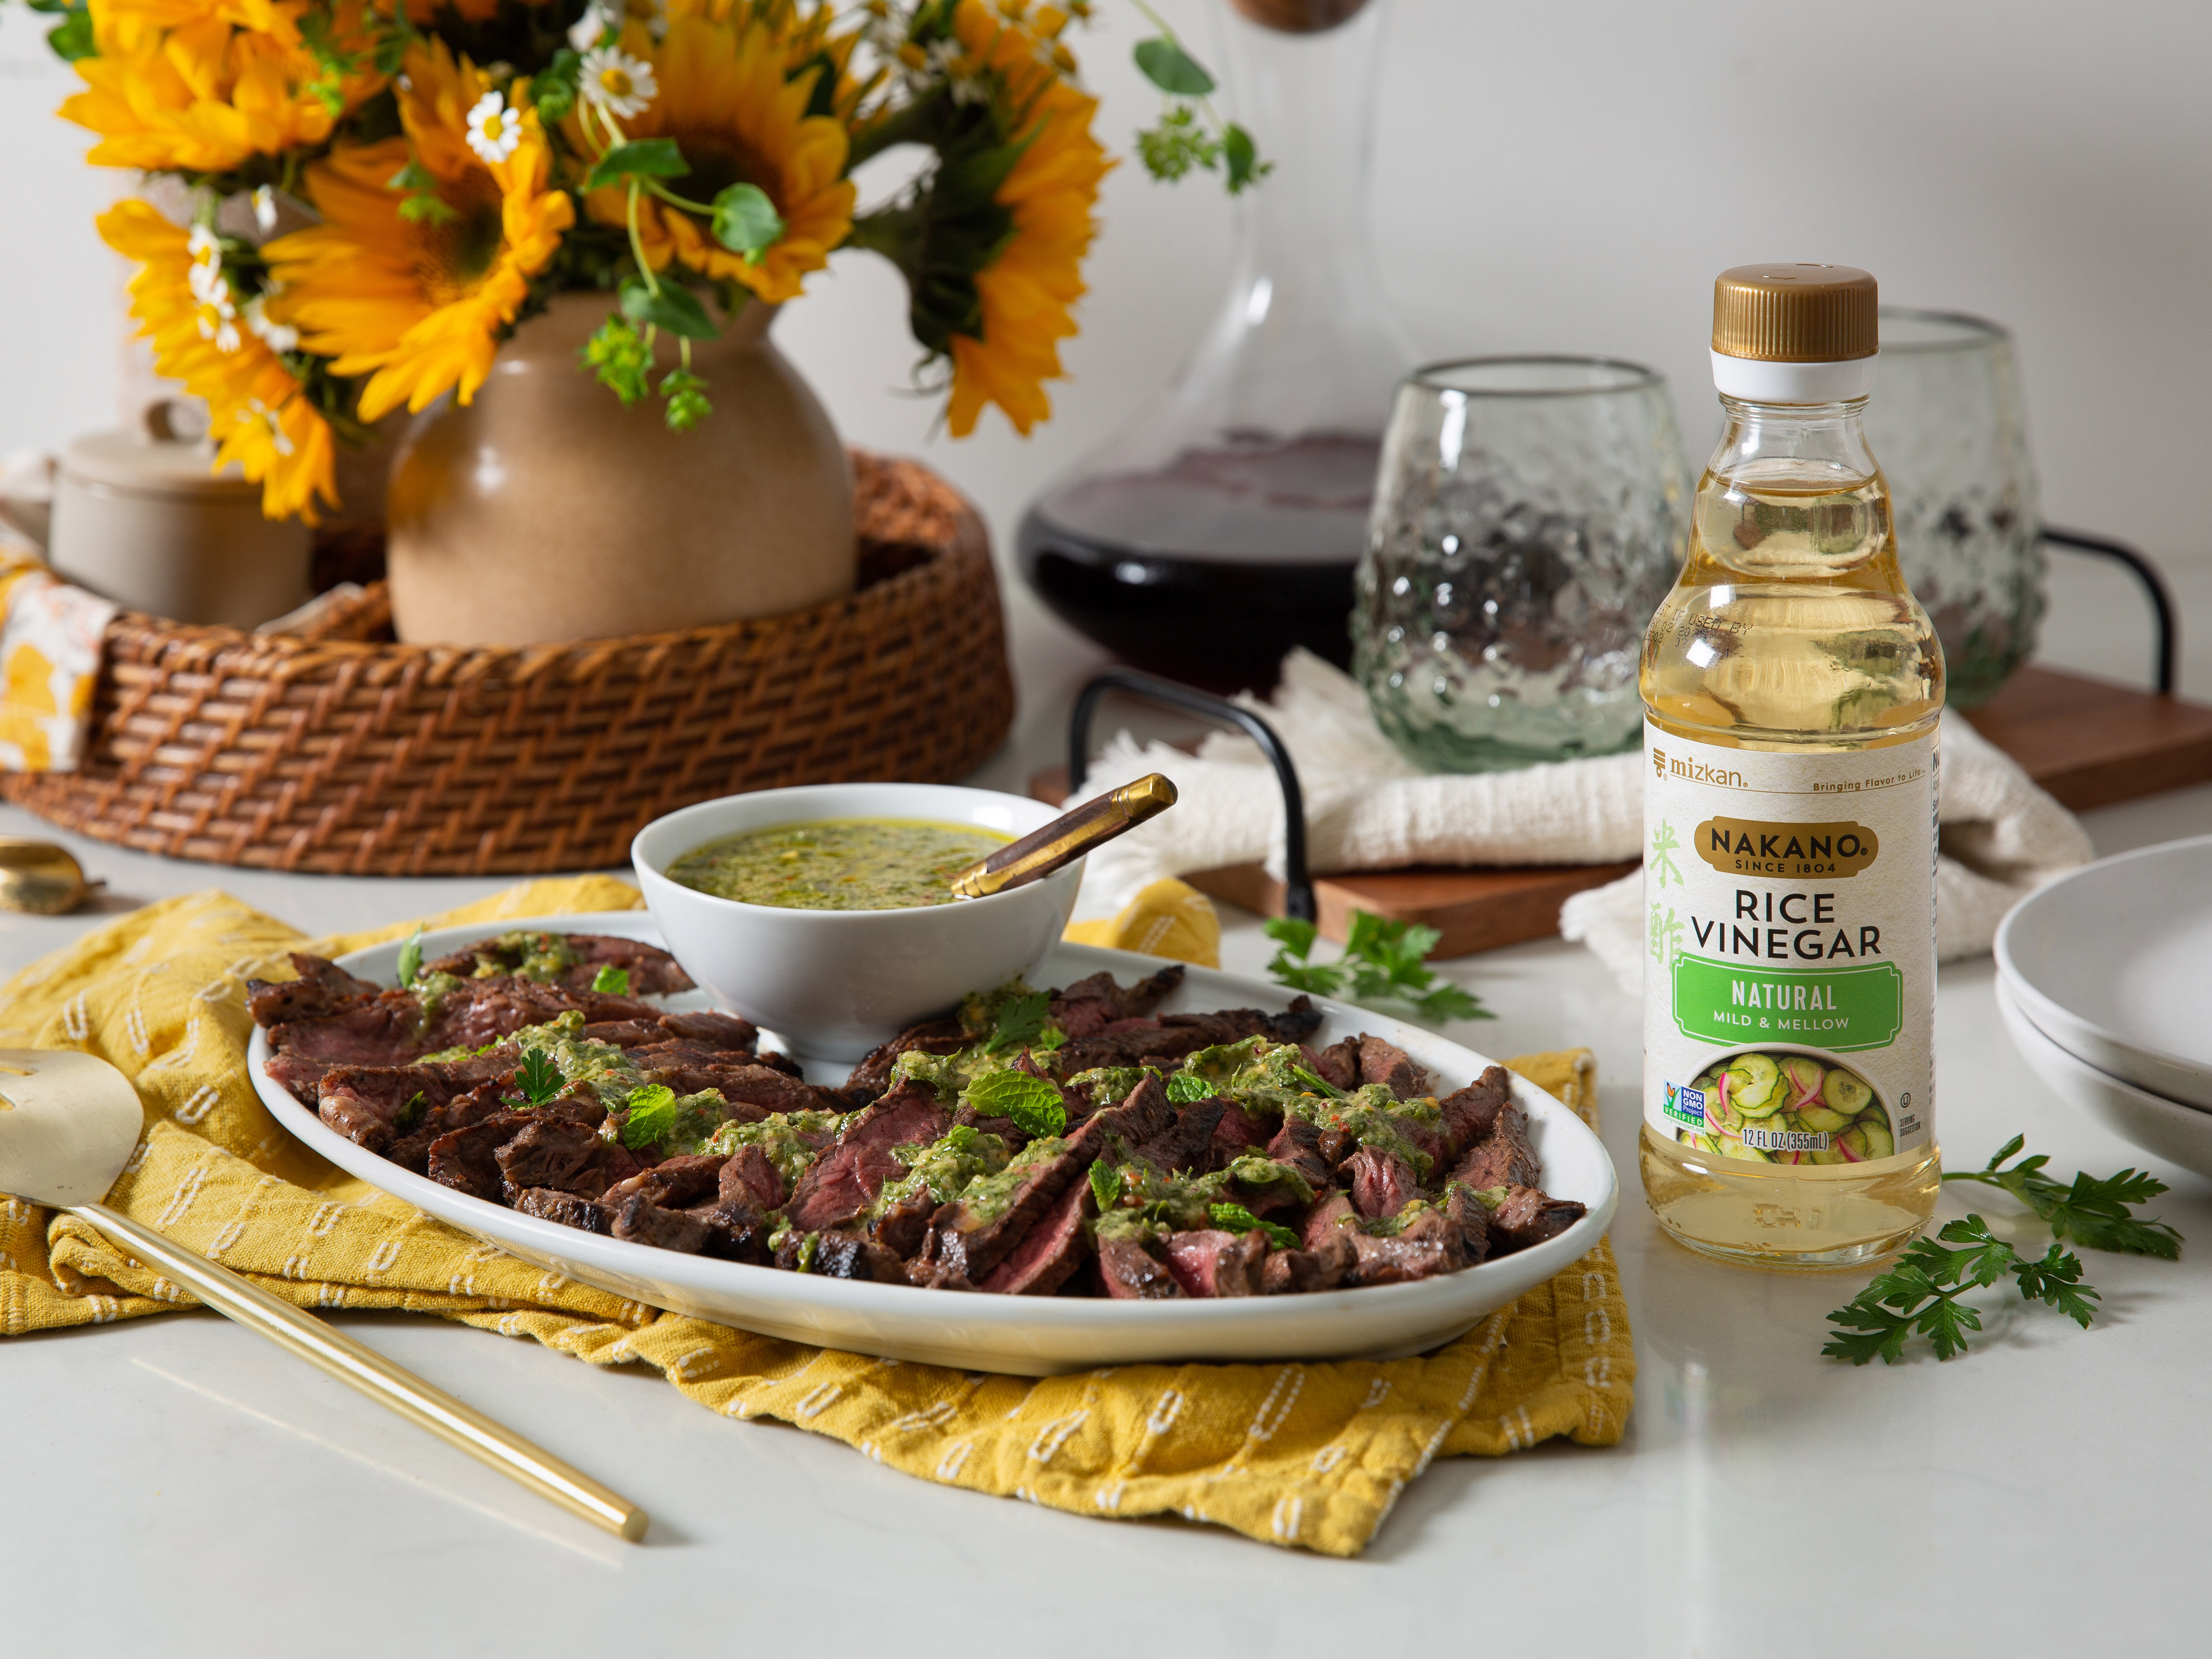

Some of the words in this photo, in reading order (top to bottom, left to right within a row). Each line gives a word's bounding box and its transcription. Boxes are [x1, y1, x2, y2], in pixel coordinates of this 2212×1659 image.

[1688, 613, 1722, 630] USED
[1729, 621, 1753, 635] BY
[1670, 757, 1742, 787] mizkan
[1813, 782, 1861, 792] Bringing
[1865, 776, 1895, 787] Flavor
[1909, 768, 1921, 778] Life
[1711, 828, 1861, 859] NAKANO
[1735, 859, 1785, 873] SINCE
[1797, 863, 1836, 873] 1804
[1736, 889, 1835, 924] RICE
[1691, 915, 1882, 960] VINEGAR
[1732, 979, 1837, 1011] NATURAL
[1714, 1010, 1752, 1026] MILD
[1759, 1017, 1770, 1029] &
[1778, 1017, 1849, 1030] MELLOW
[1683, 1089, 1702, 1102] NON
[1683, 1098, 1703, 1110] GMO
[1664, 1106, 1703, 1126] VERIFIED
[1683, 1105, 1703, 1116] Project
[1743, 1129, 1754, 1146] 12
[1757, 1130, 1768, 1147] FL
[1771, 1132, 1784, 1148] OZ
[1787, 1132, 1827, 1150] (355mL)
